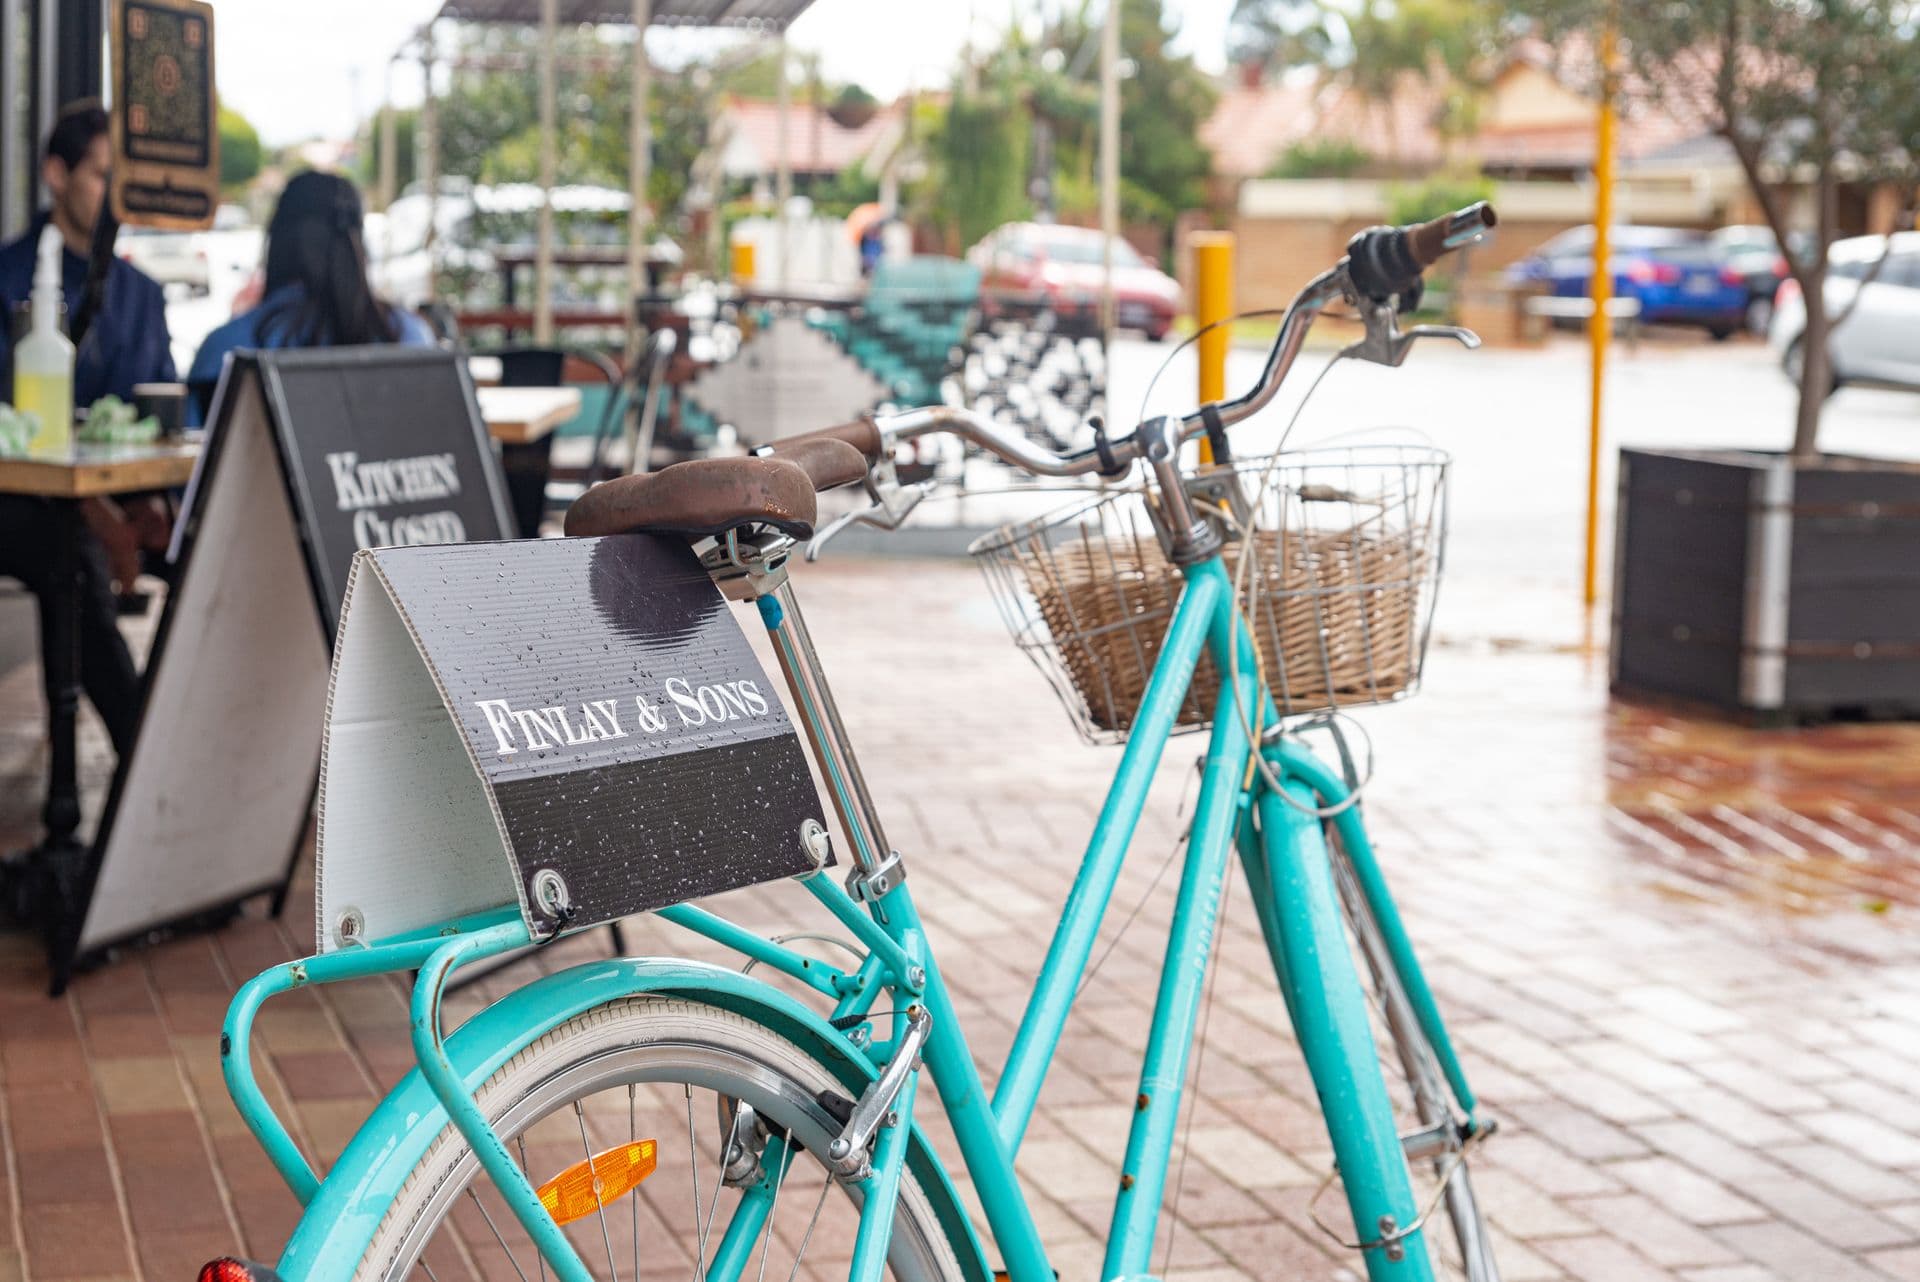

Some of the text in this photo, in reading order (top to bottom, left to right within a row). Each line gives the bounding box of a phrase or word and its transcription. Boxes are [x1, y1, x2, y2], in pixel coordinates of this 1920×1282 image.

[325, 451, 462, 511] KITCHEN
[475, 677, 769, 755] FINLAY & SONS
